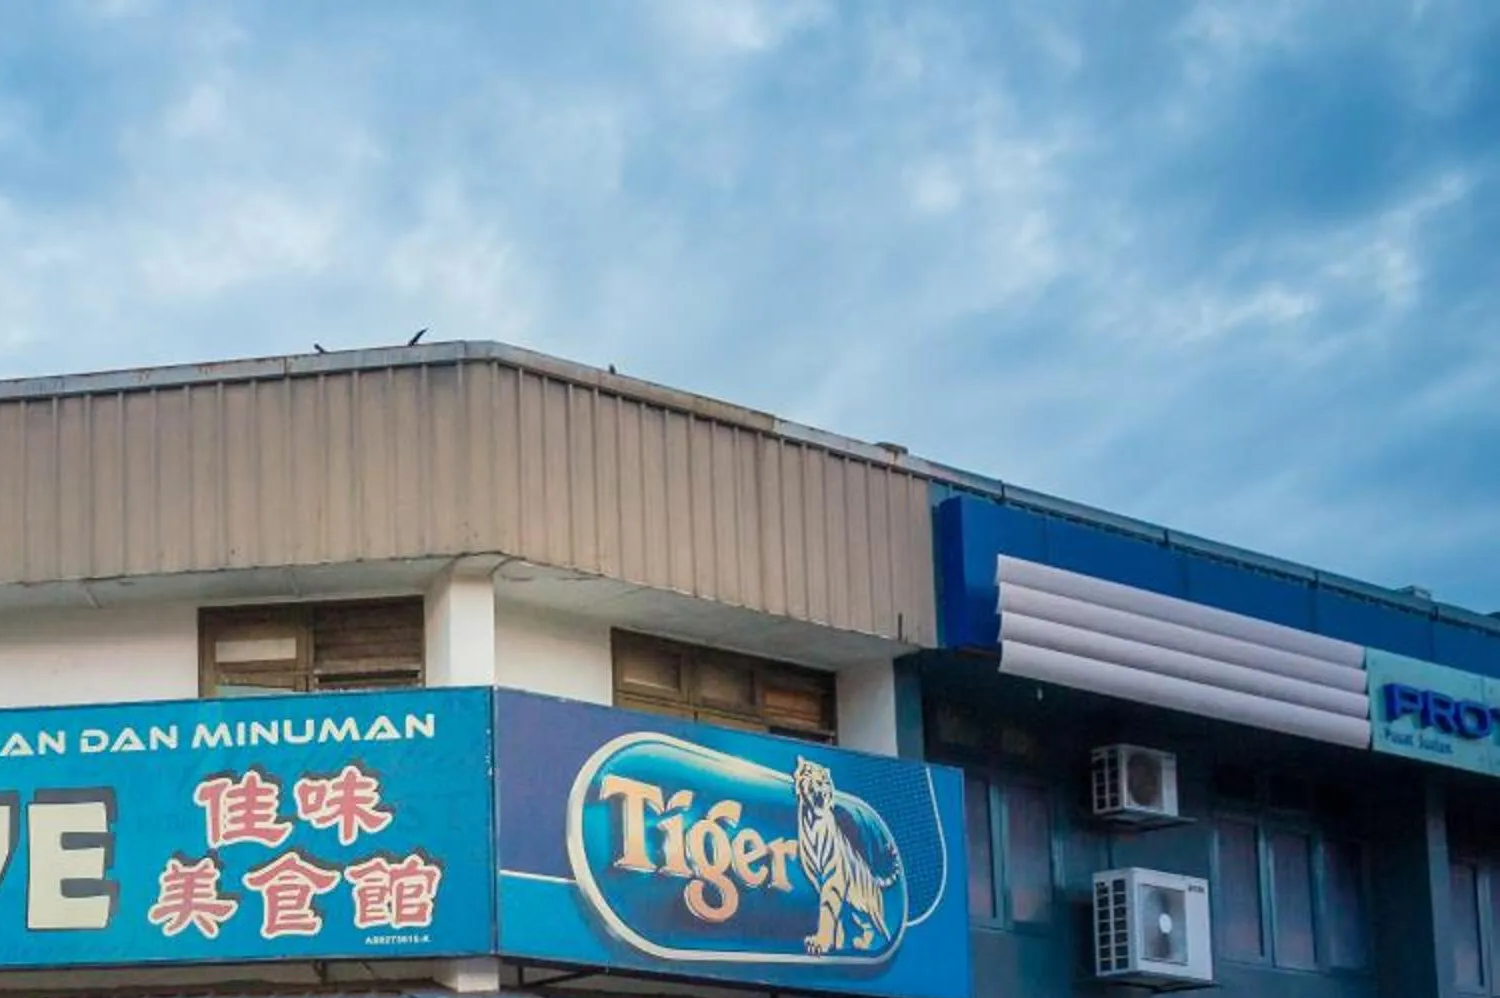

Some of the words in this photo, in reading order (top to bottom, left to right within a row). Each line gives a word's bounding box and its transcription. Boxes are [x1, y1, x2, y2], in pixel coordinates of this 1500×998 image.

[79, 725, 180, 754] DAN
[190, 713, 437, 750] MINUMAN
[1383, 683, 1500, 740] PRO
[193, 764, 393, 848] 佳味
[599, 774, 798, 924] Tiger
[148, 850, 442, 940] 美食館
